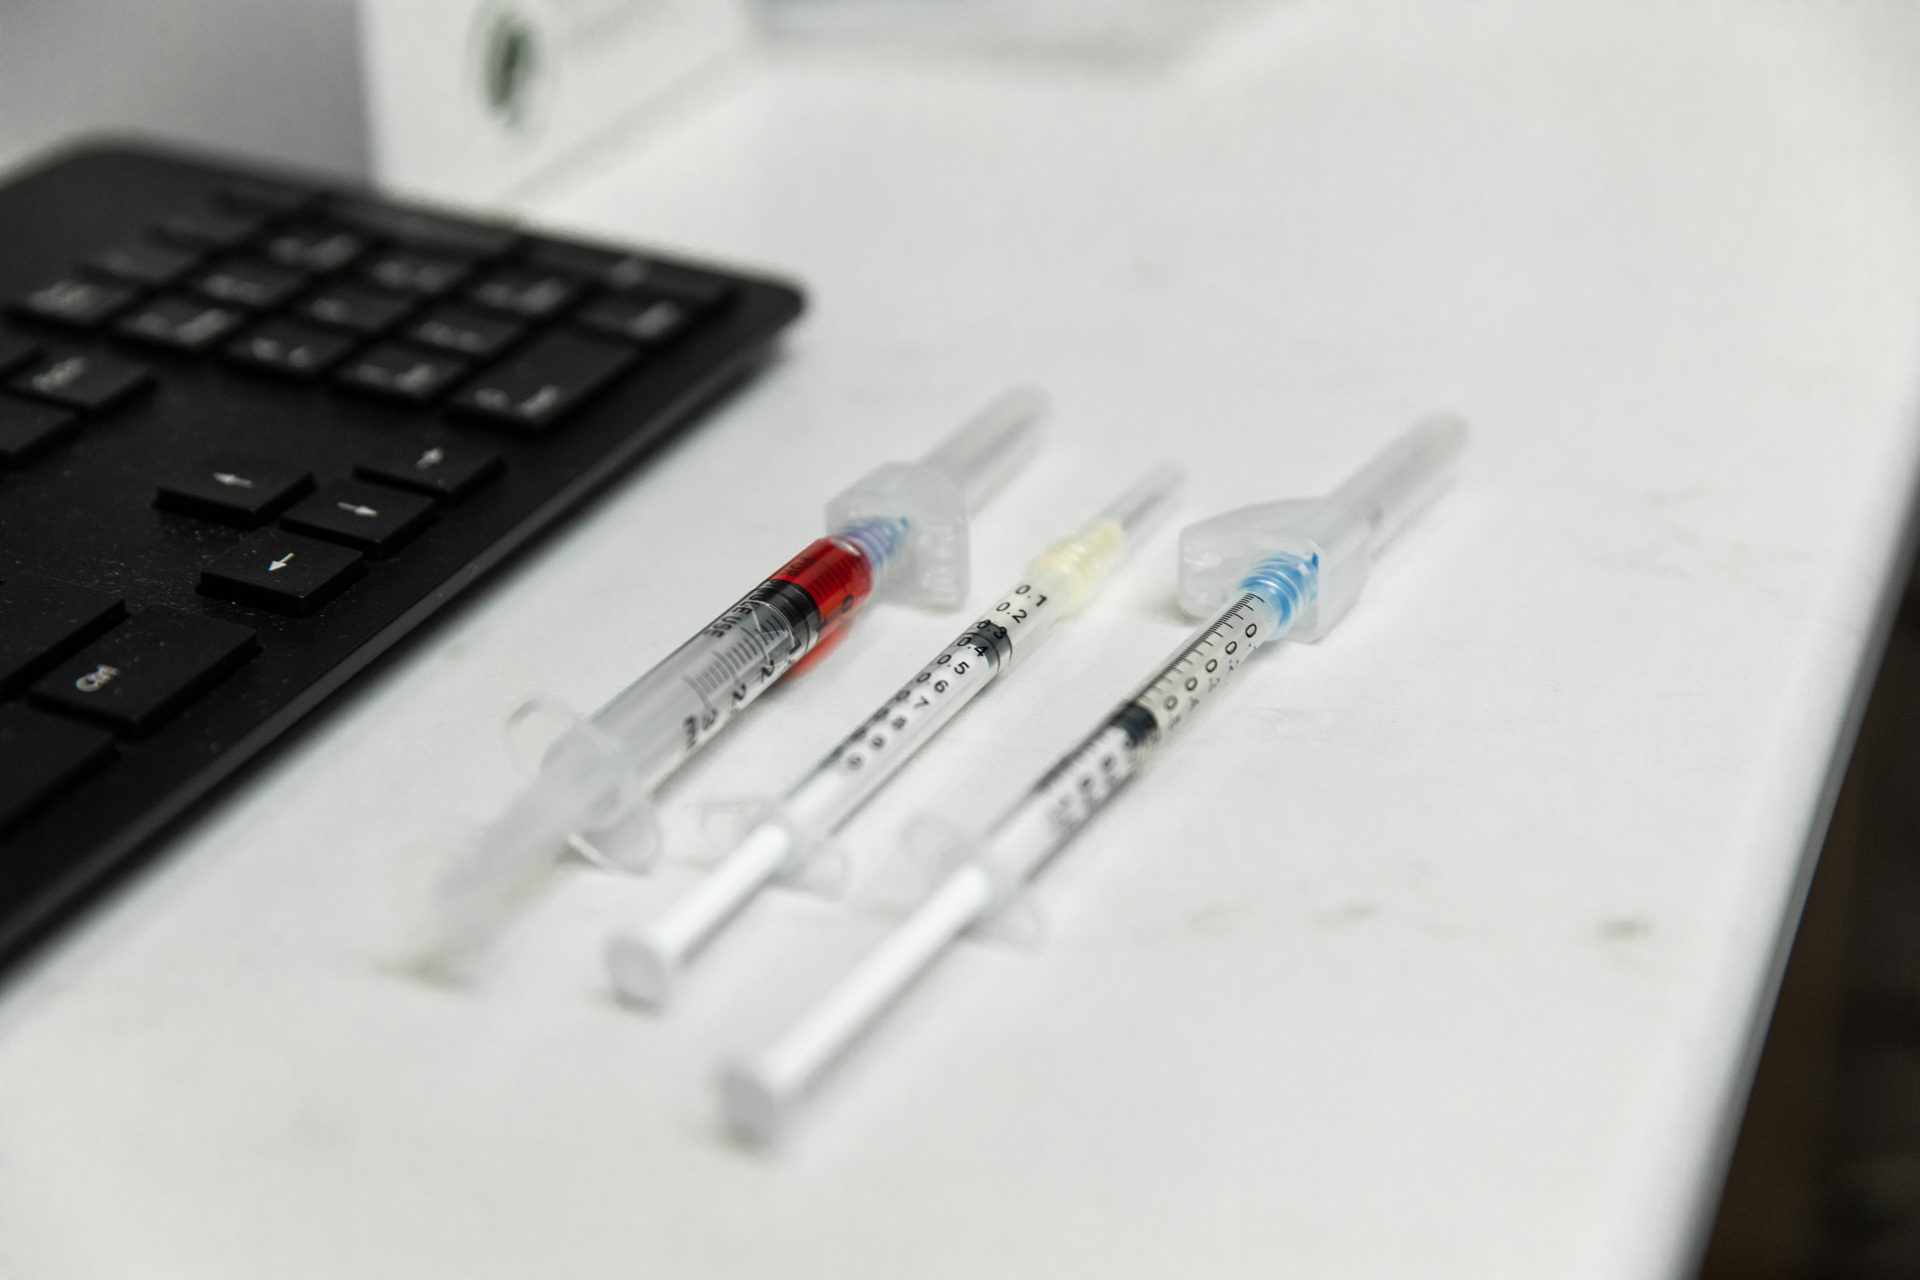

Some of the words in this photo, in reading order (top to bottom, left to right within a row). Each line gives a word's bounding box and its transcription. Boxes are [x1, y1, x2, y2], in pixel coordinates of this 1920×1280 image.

[1015, 585, 1048, 607] 0.1
[996, 602, 1028, 624] 0.2
[977, 618, 1008, 640] 0.3
[957, 637, 989, 657] 0.4
[937, 654, 970, 675] 0.5
[916, 672, 949, 693] 0.6
